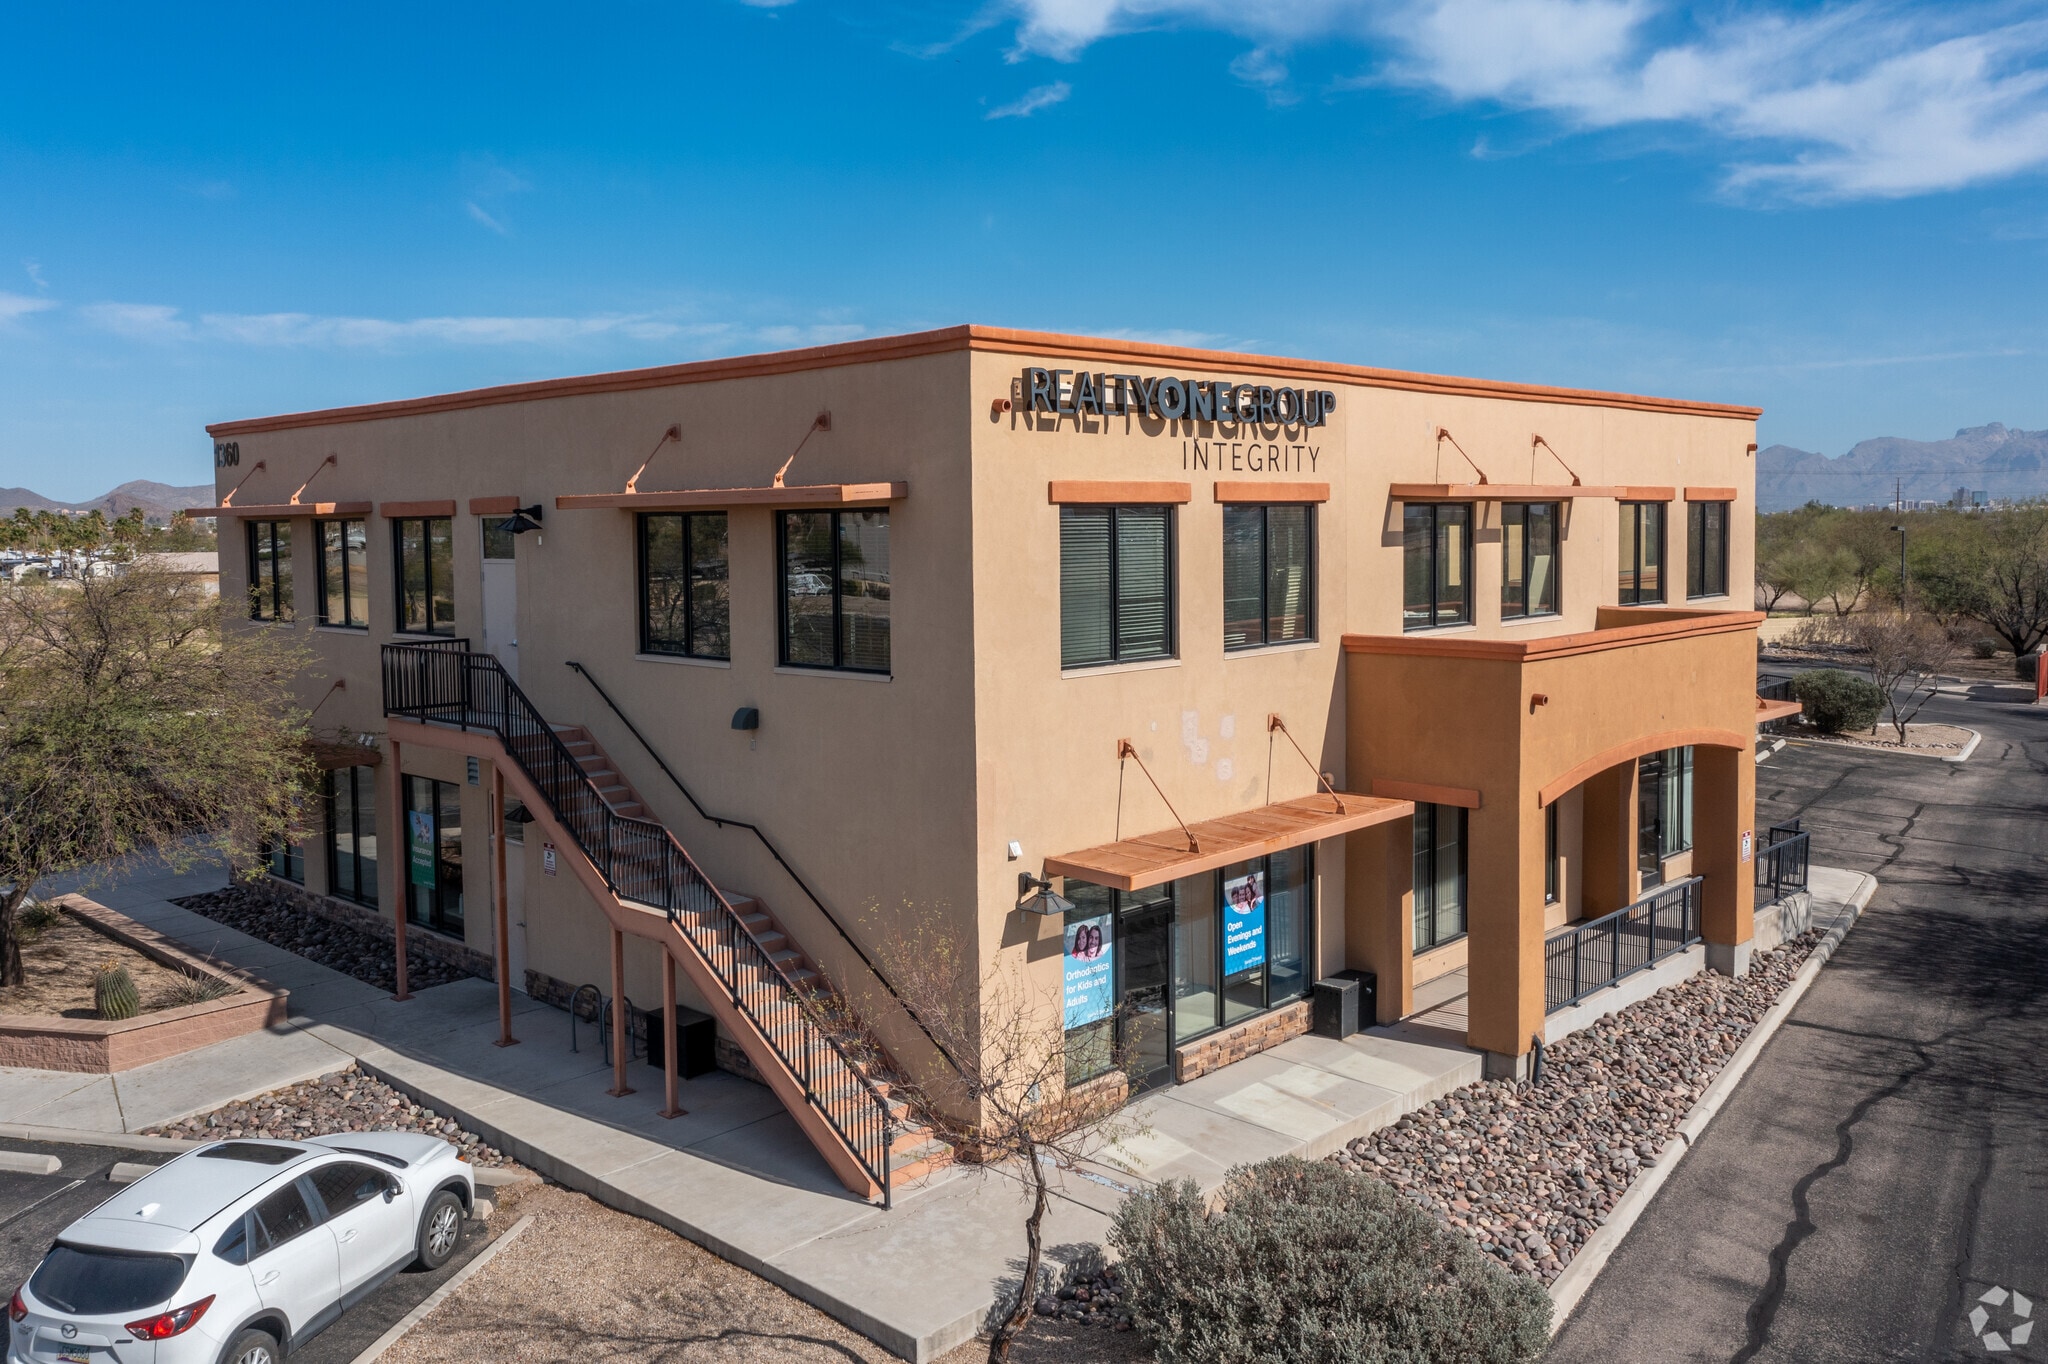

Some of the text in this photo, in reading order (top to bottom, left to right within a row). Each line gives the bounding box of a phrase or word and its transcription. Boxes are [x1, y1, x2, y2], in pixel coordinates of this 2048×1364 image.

[214, 441, 240, 468] 1360
[1183, 440, 1320, 473] INTEGRITY
[1227, 921, 1243, 933] Open
[1227, 924, 1263, 945] Evenings and
[1227, 940, 1257, 957] Weekends
[1066, 962, 1110, 982] Orthodontics
[1066, 974, 1107, 995] for Kids and
[1066, 995, 1089, 1009] Adults
